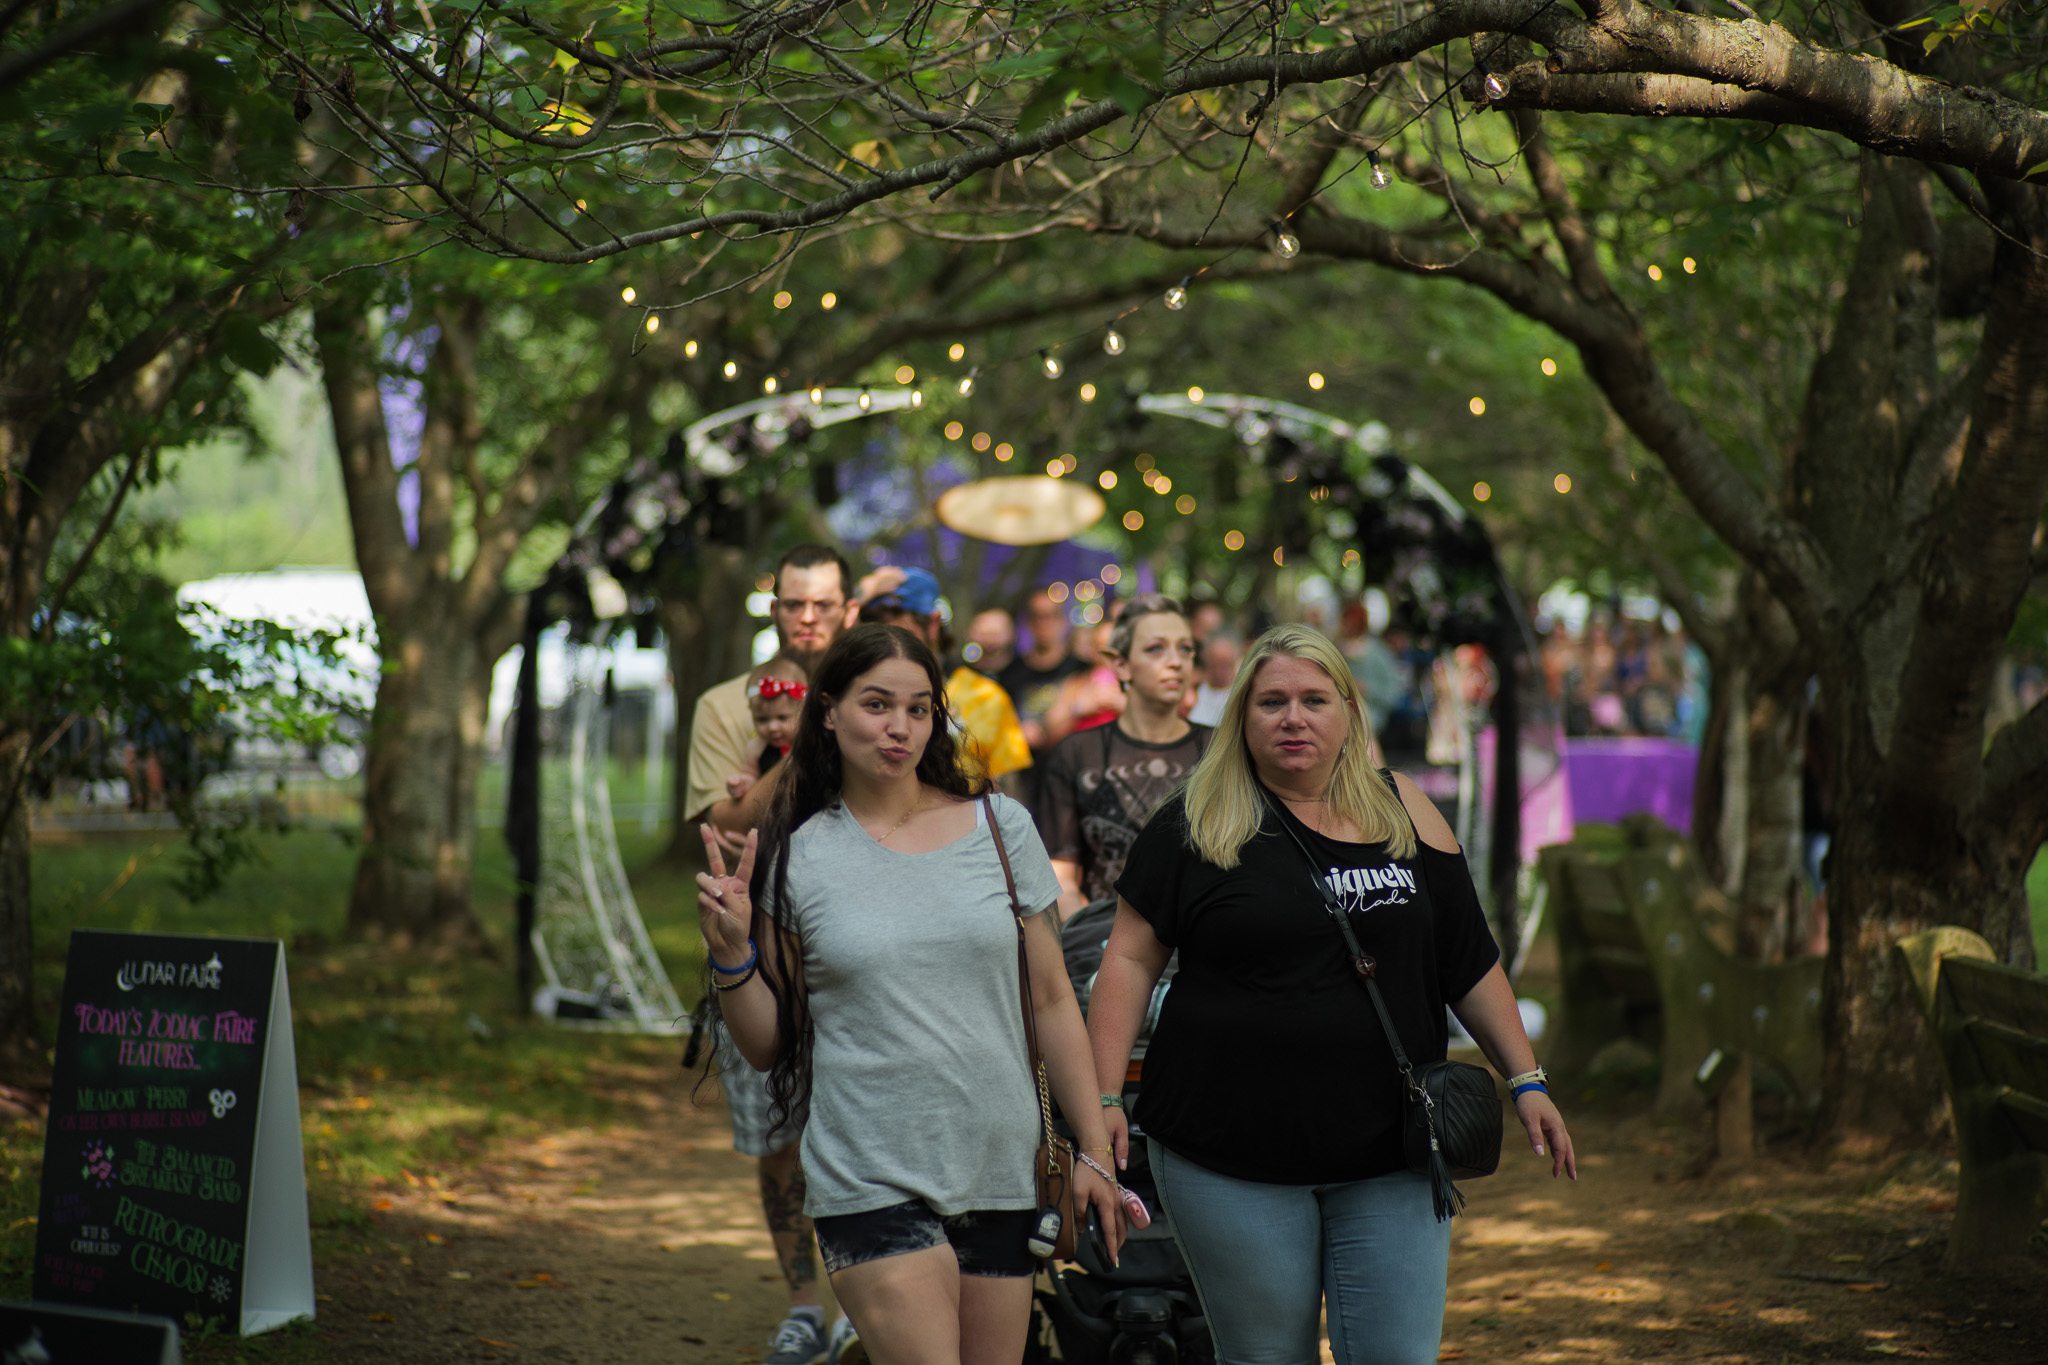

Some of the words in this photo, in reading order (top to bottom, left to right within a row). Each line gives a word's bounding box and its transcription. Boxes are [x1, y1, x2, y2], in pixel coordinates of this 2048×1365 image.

[123, 960, 175, 987] LUNAR
[75, 1003, 143, 1037] TODAY'S
[147, 1009, 209, 1042] ZODIAC
[213, 1010, 258, 1045] FAIRE
[77, 1087, 139, 1111] MEADOW
[198, 1174, 242, 1204] BAND
[113, 1196, 244, 1272] RETROGRADE
[131, 1241, 209, 1294] CHAOS!
